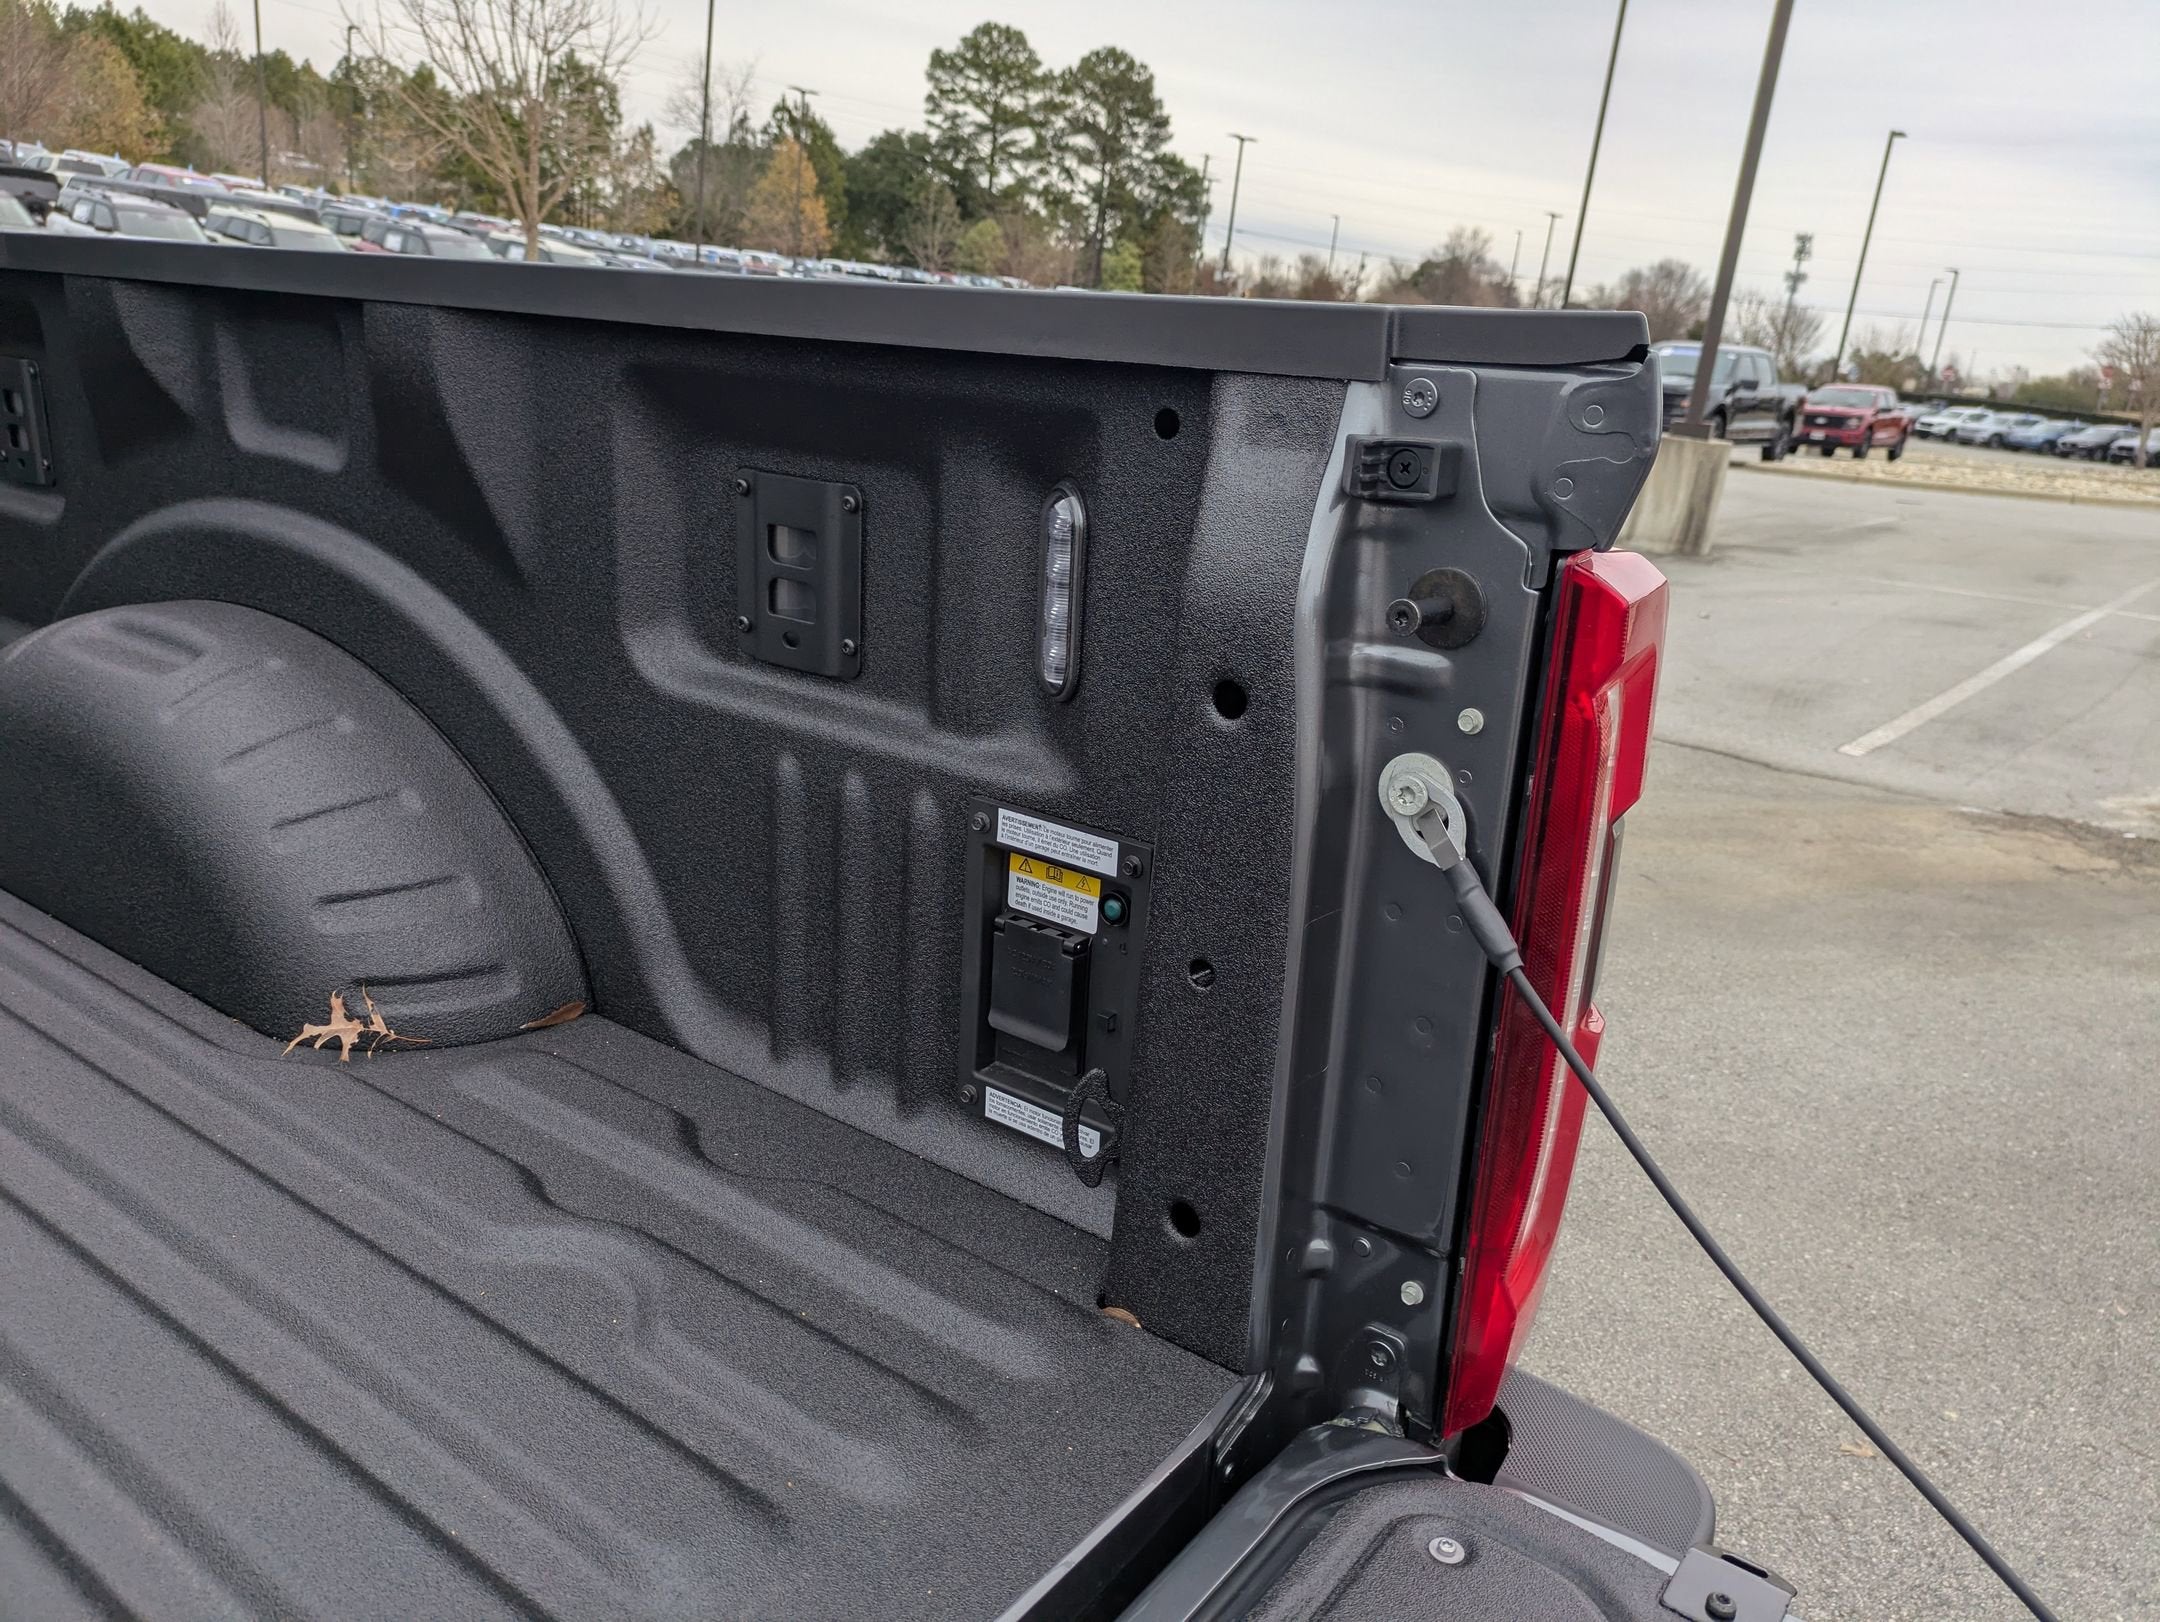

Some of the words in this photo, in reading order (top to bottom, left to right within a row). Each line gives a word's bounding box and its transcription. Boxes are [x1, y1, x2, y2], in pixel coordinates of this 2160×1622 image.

[1024, 828, 1044, 838] Utilisation
[1097, 850, 1113, 858] Quand
[1035, 844, 1050, 853] garage
[1050, 830, 1065, 838] moteur
[1066, 834, 1080, 842] tourne
[1081, 838, 1092, 847] pour
[1093, 842, 1113, 851] alimenter
[1080, 850, 1101, 861] utilisation
[1016, 876, 1041, 890] WARNING:
[1042, 884, 1057, 895] Engine
[1080, 898, 1095, 906] power
[1015, 900, 1027, 908] death
[1032, 904, 1042, 913] used
[1043, 908, 1056, 917] inside
[1032, 890, 1048, 899] outside
[1069, 901, 1088, 913] Running
[1061, 907, 1074, 915] could
[1074, 912, 1088, 920] cause
